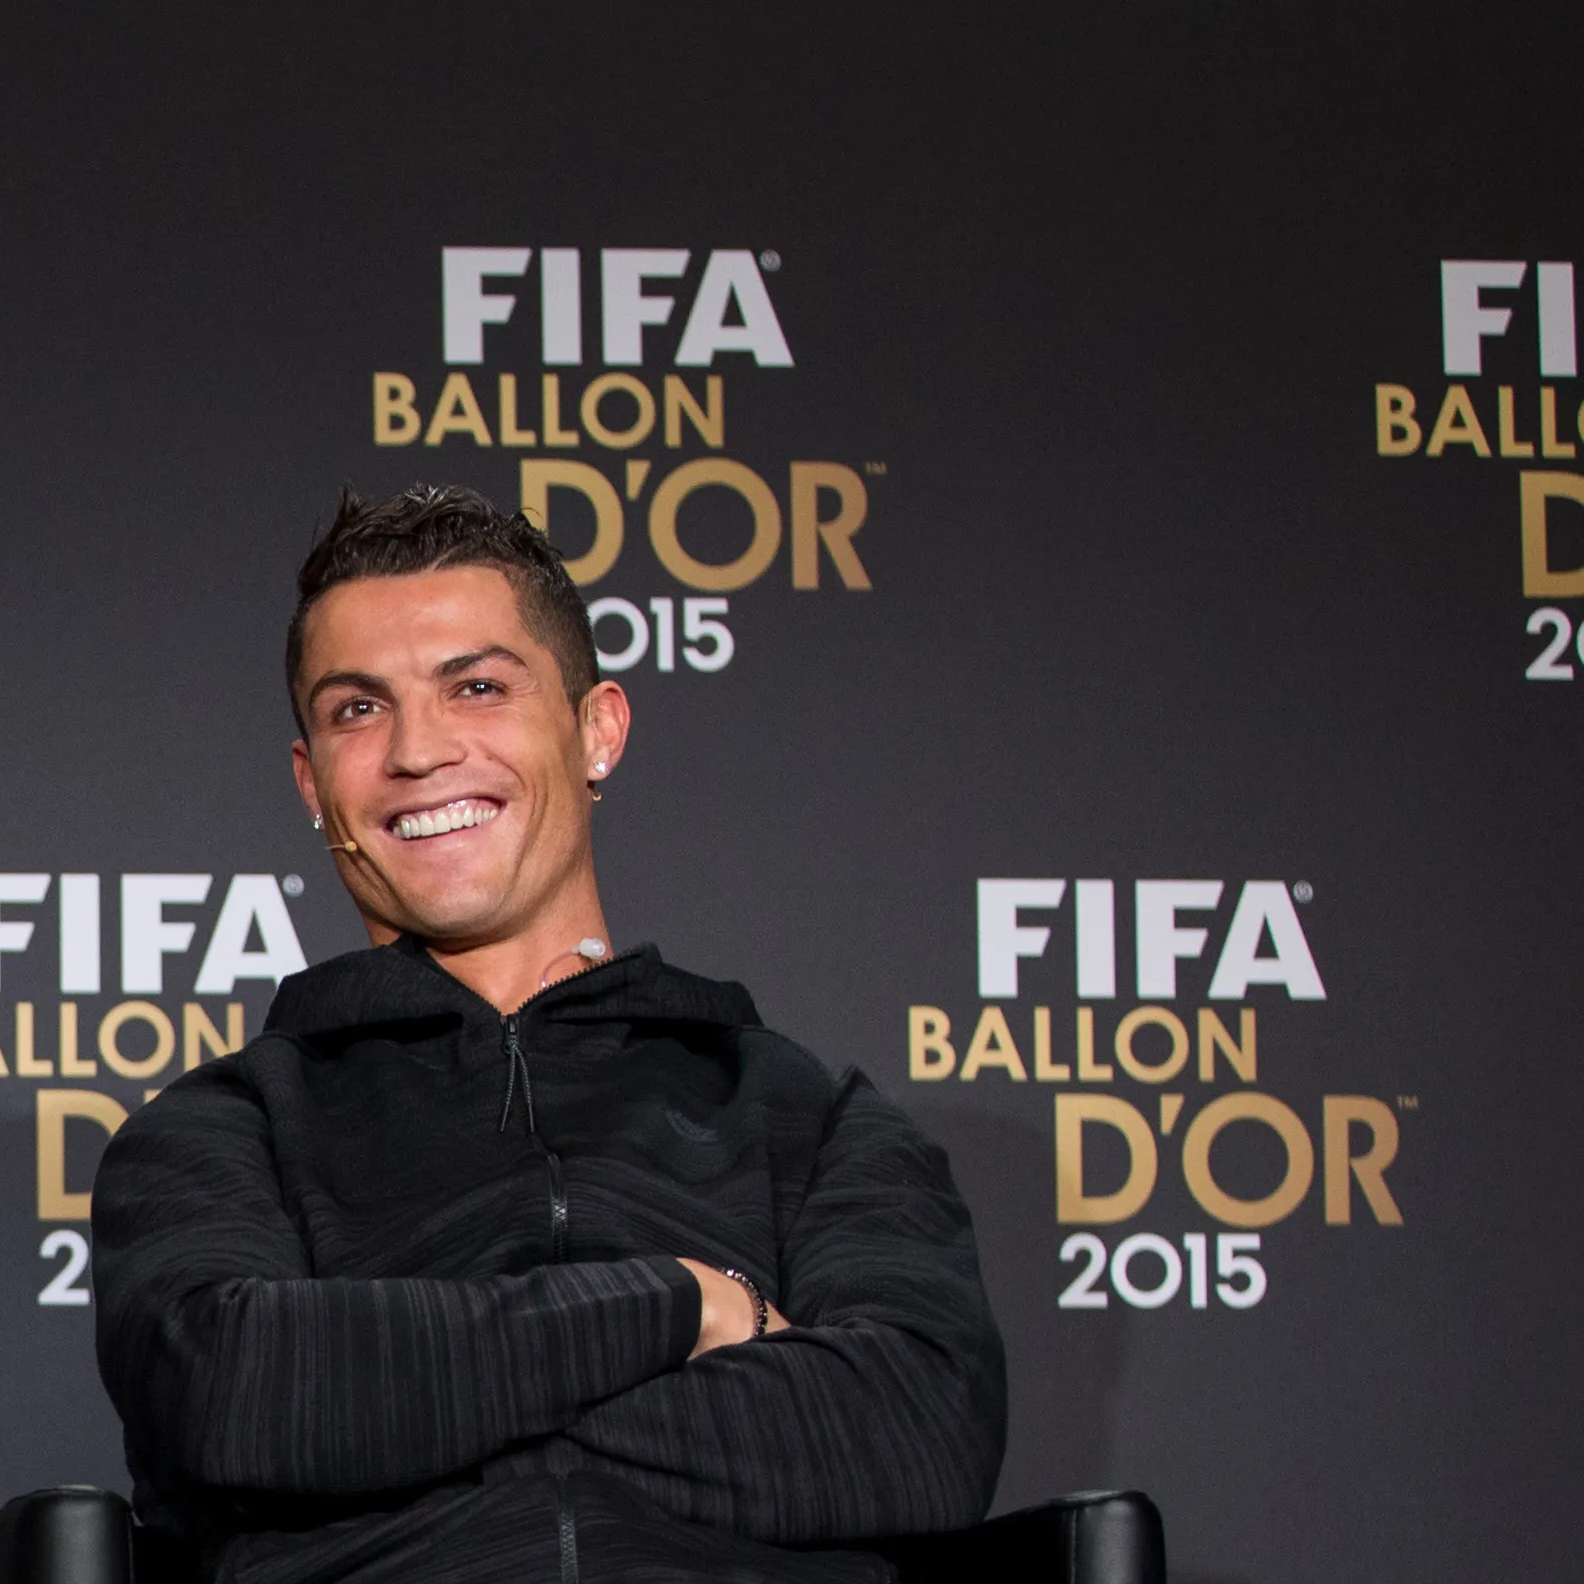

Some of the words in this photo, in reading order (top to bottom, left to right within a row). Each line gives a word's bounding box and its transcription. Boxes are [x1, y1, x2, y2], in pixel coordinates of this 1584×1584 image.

[441, 246, 795, 368] FIFA
[1441, 260, 1577, 377] FI
[372, 370, 726, 450] BALLON
[1374, 382, 1584, 459] BALL
[519, 456, 872, 592] D'OR
[586, 595, 736, 673] 015
[976, 876, 1328, 1001] FIFA
[908, 1003, 1259, 1085] BALLON
[1054, 1092, 1404, 1229] D'OR
[1057, 1231, 1268, 1310] 2015
